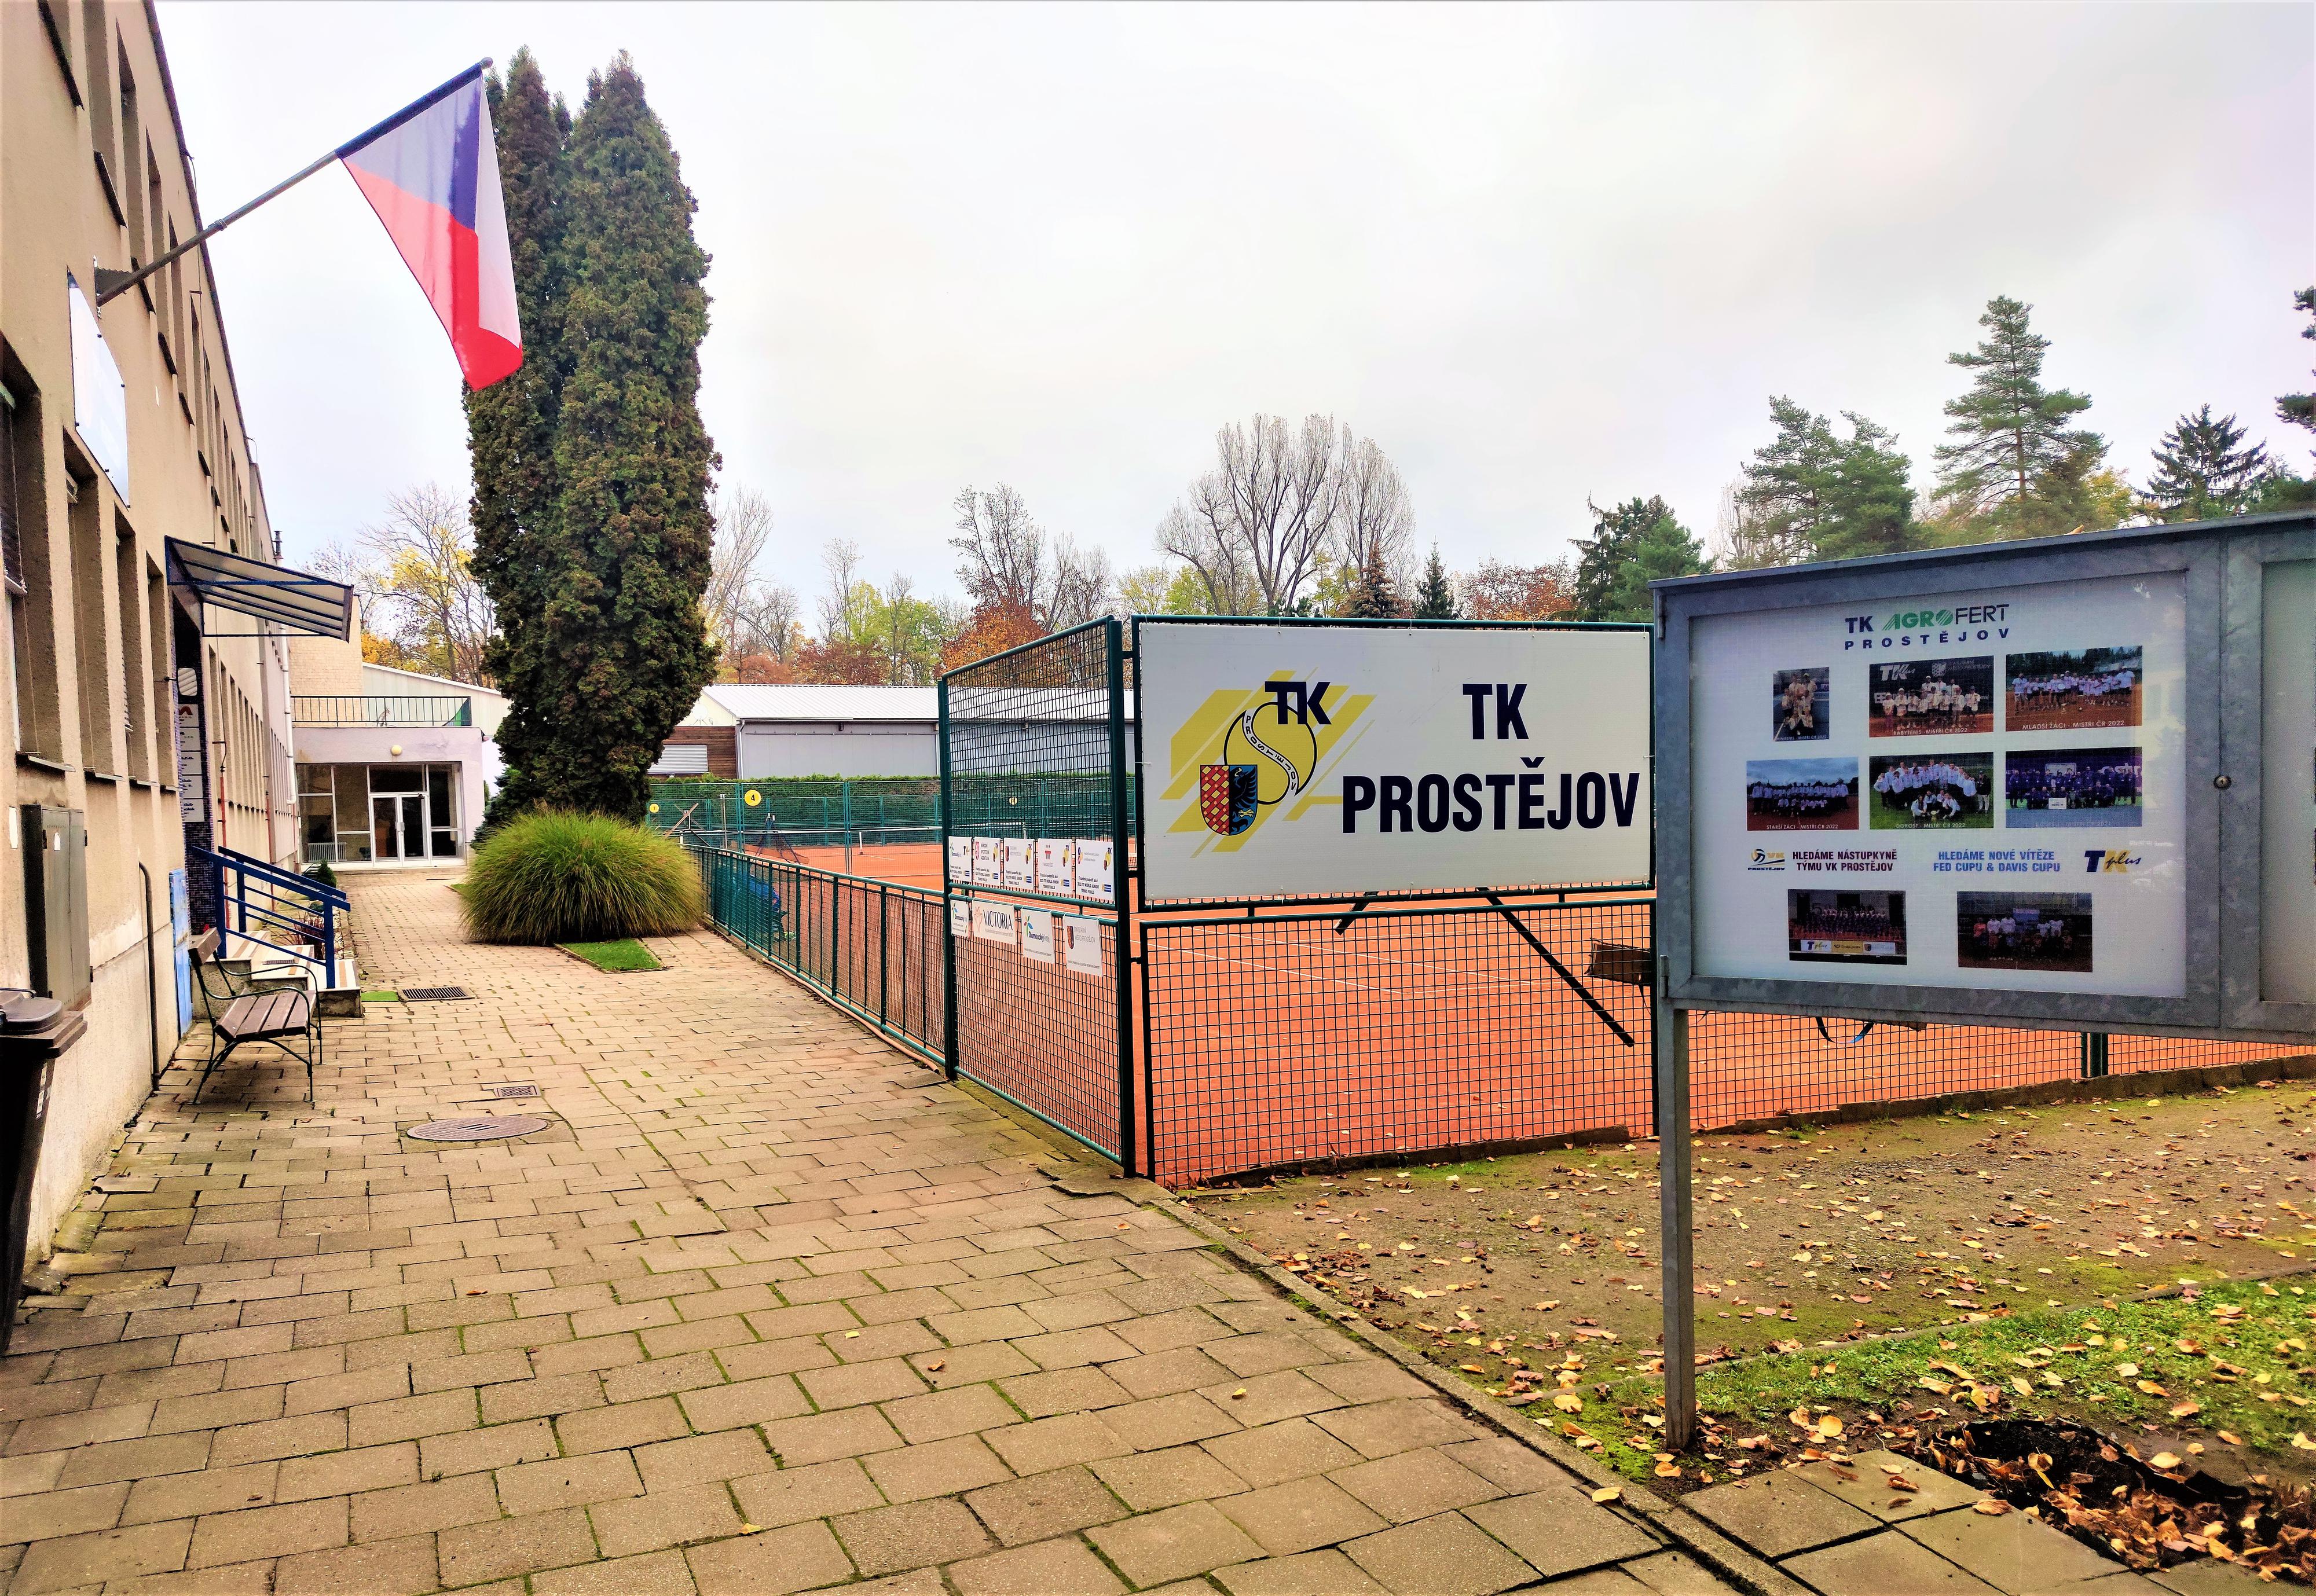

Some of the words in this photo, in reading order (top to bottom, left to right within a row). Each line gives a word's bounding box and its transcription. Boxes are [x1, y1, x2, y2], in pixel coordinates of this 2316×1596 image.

[1845, 615, 1874, 633] TK
[1882, 604, 2009, 631] AGROFERT
[1845, 628, 2009, 650] PROSTĚJOV
[1880, 664, 1910, 681] TK
[1265, 681, 1332, 725] TK
[1463, 684, 1529, 740] TK
[1245, 715, 1297, 791] PROSTĚJOV
[1343, 757, 1640, 834] PROSTĚJOV
[1793, 849, 1834, 860] HLEDÁME
[1837, 849, 1897, 860] NÁSTUPKYNĚ
[1797, 860, 1822, 871] TÝMU
[1826, 863, 1837, 871] VK
[1841, 860, 1893, 871] PROSTĚJOV
[1938, 849, 1985, 860] HLEDÁME
[1989, 849, 2015, 860] NOVÉ
[2020, 849, 2054, 860] VÍTĚZE
[2084, 850, 2131, 872] TK
[2105, 853, 2142, 869] plus
[1933, 863, 1951, 871] FED
[1955, 863, 1982, 871] CUPU
[1987, 863, 1995, 871] &
[1998, 863, 2028, 871] DAVIS
[2032, 863, 2060, 872] CUPU
[983, 909, 1013, 931] VICTORIA
[1029, 931, 1045, 942] Olomoucký
